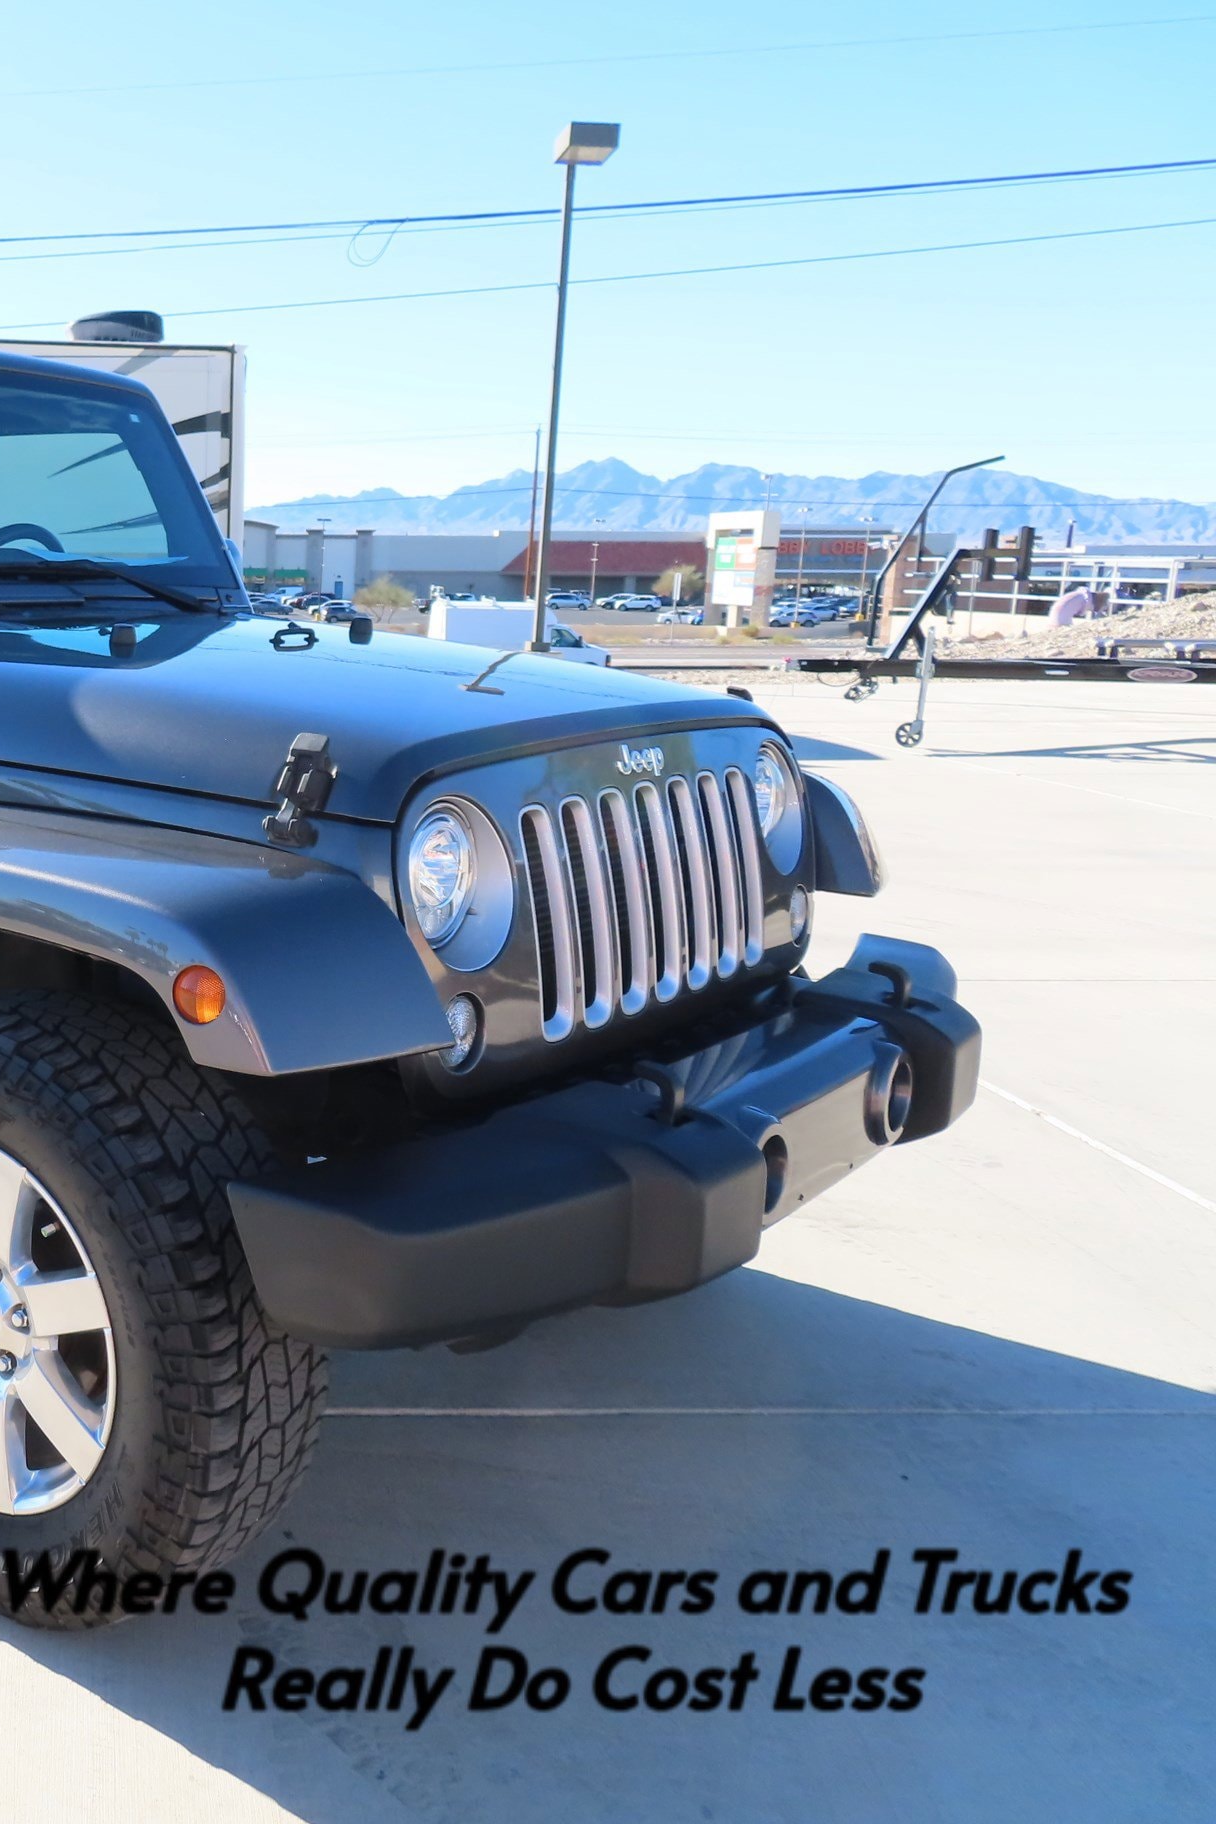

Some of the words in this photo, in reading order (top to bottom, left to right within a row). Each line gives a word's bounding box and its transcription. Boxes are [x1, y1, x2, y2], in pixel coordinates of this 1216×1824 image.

[778, 540, 810, 555] BBY
[821, 540, 874, 556] LOBB
[615, 744, 664, 777] Jeep
